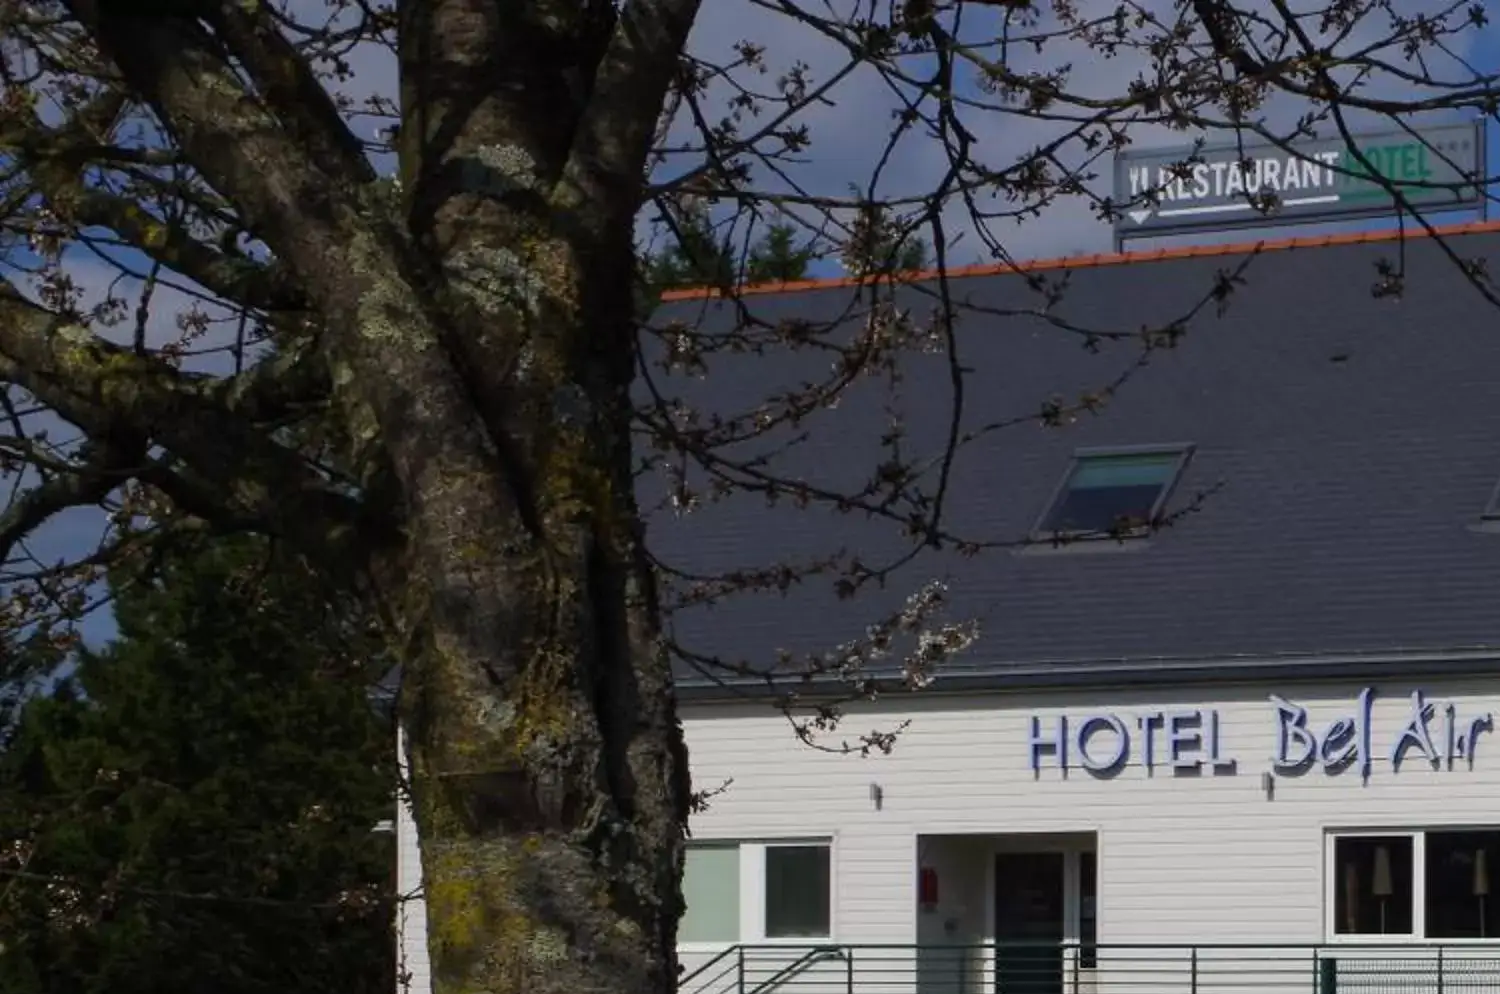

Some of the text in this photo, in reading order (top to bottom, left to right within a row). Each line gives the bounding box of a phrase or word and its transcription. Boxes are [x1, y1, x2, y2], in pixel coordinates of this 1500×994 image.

[1026, 687, 1494, 786] HOTEL Bel Air
